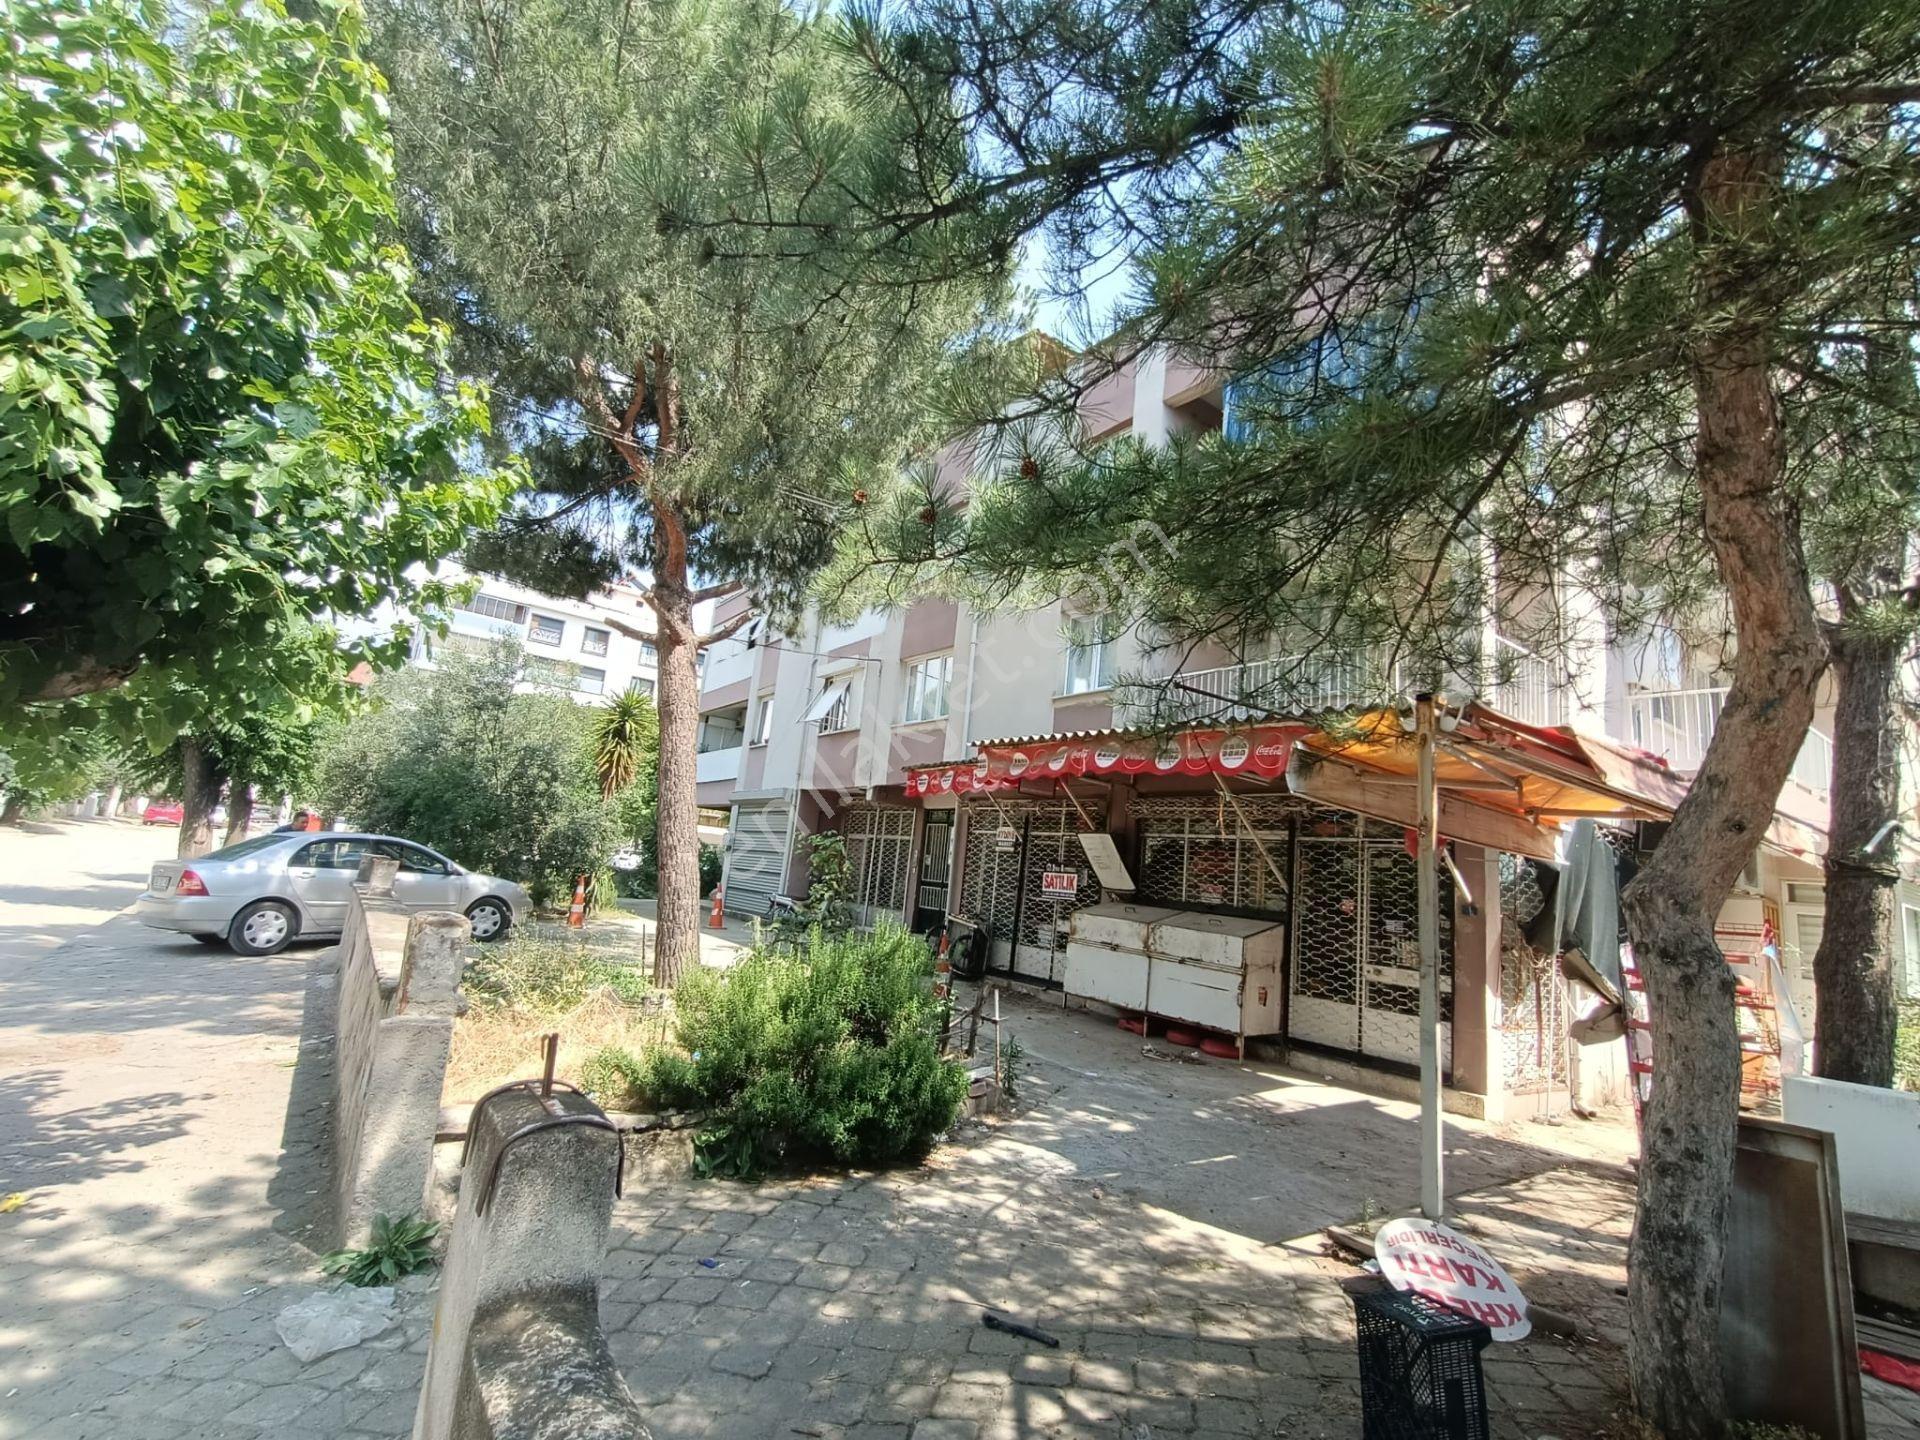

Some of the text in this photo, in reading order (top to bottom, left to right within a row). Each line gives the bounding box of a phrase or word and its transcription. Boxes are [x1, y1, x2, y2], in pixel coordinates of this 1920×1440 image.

[1044, 874, 1075, 890] SATILIK
[1393, 1253, 1506, 1293] KARTI
[1405, 1280, 1522, 1328] KRE
